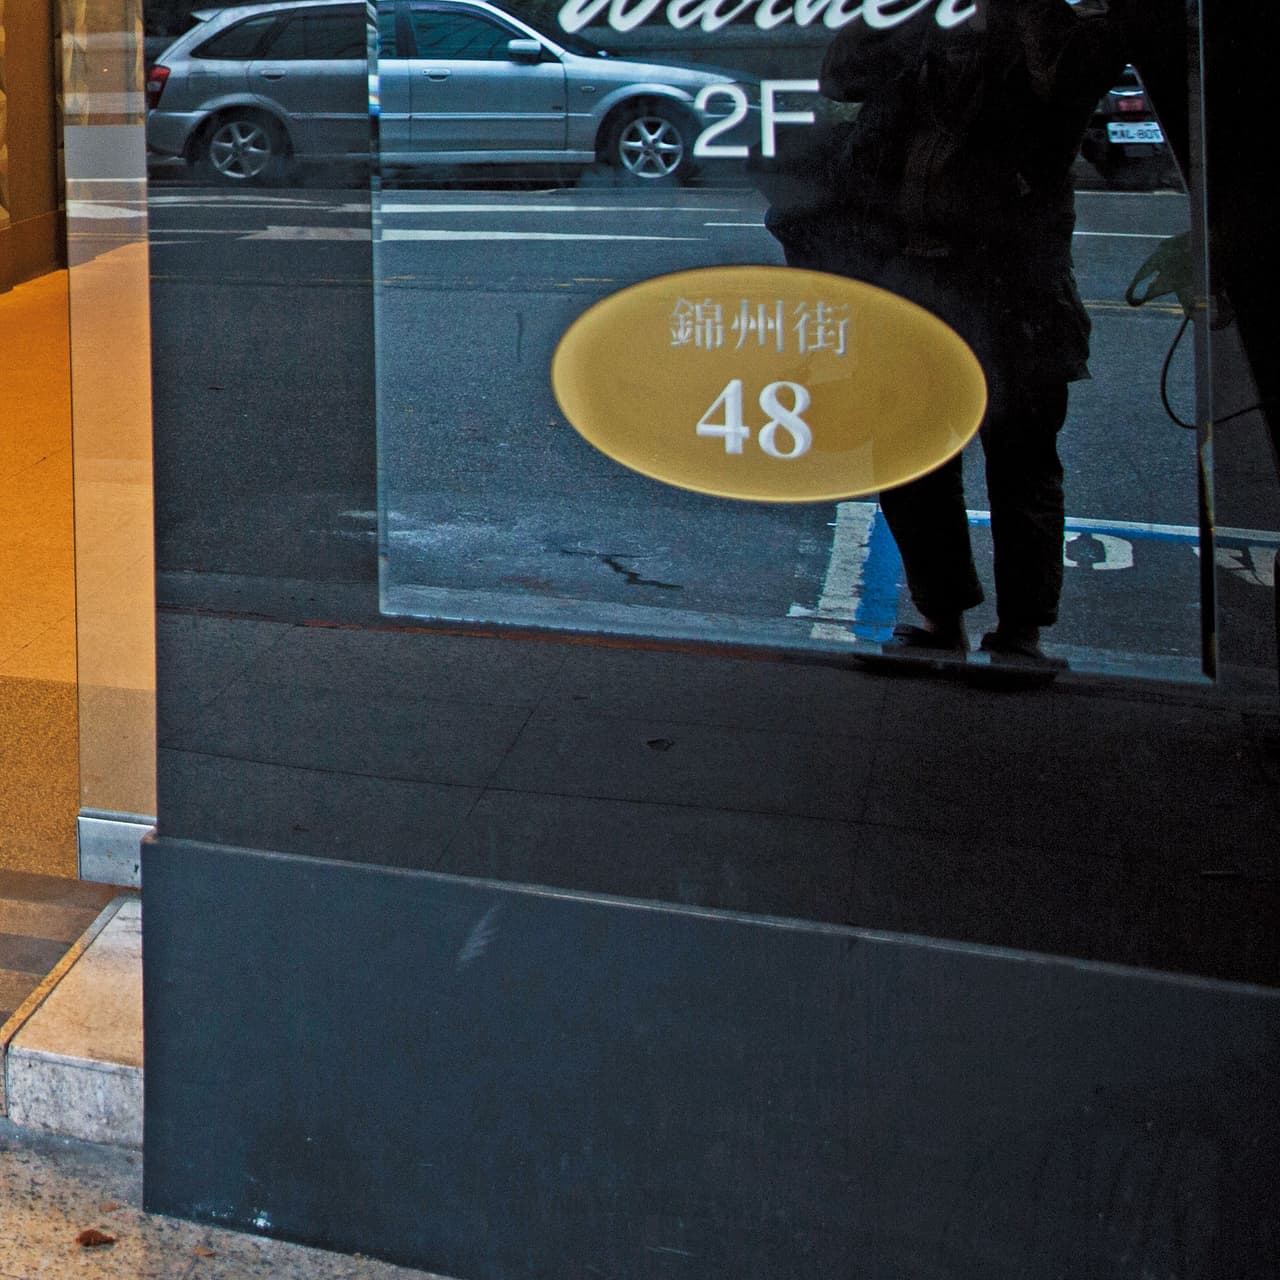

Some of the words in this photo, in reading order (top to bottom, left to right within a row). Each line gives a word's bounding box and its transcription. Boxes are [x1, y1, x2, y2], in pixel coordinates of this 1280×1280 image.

[693, 80, 820, 158] 2F
[669, 299, 851, 356] 錦州街
[696, 379, 812, 458] 48
